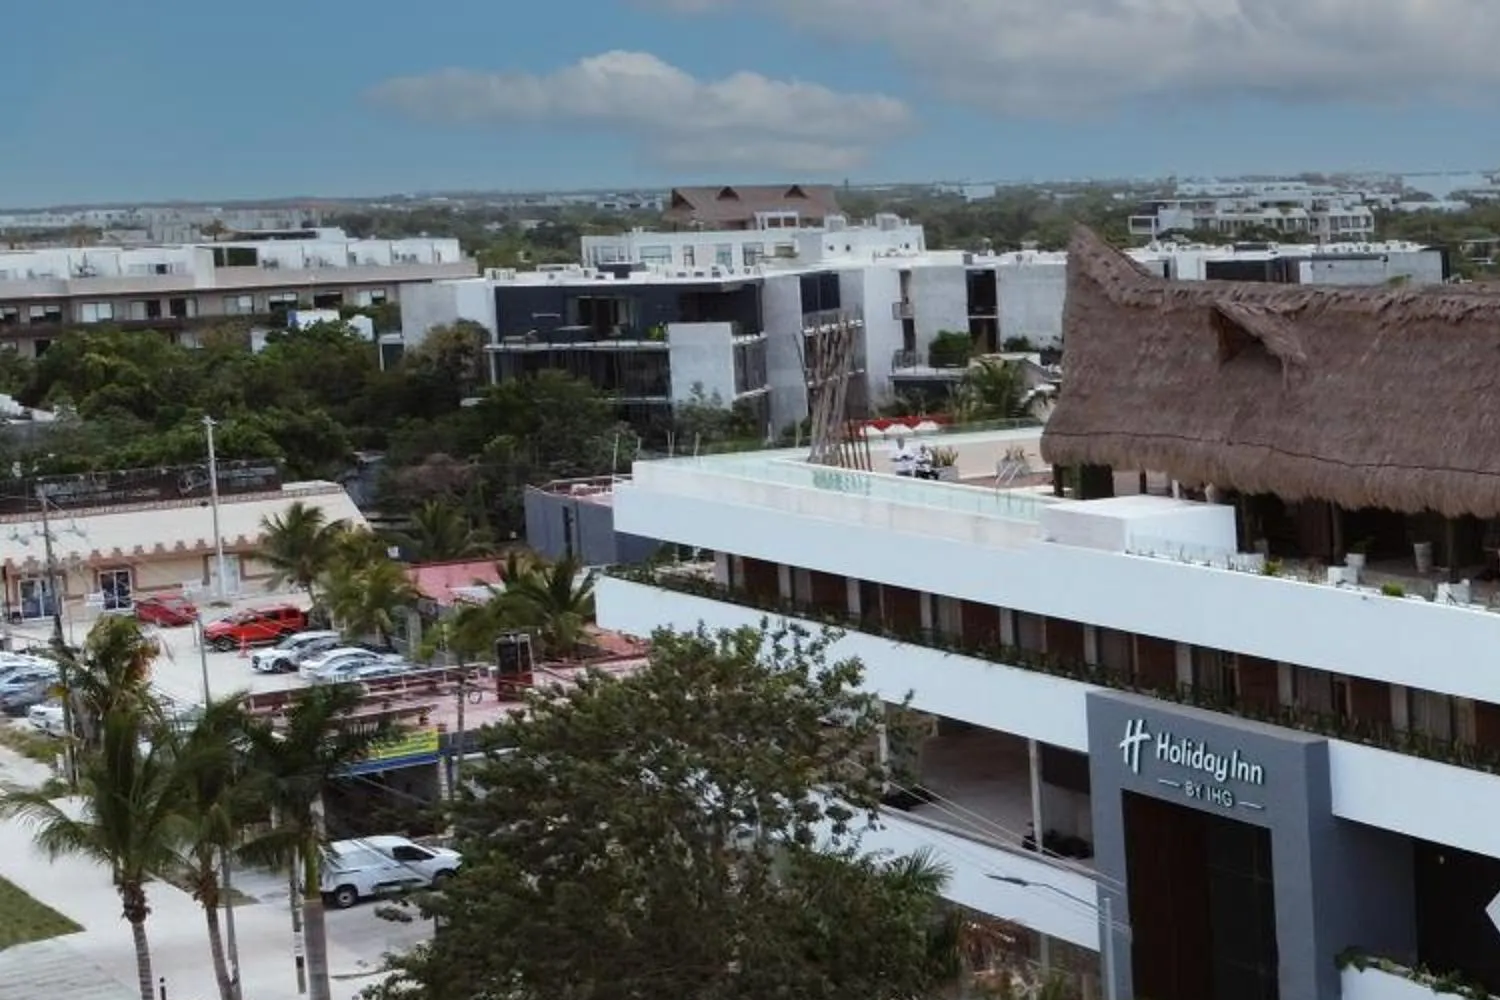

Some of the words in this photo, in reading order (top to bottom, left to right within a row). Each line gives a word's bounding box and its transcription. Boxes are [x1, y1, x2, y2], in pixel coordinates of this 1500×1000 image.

[1156, 732, 1228, 783] Holiday
[1231, 749, 1264, 785] Inn
[1207, 787, 1233, 807] IHG
